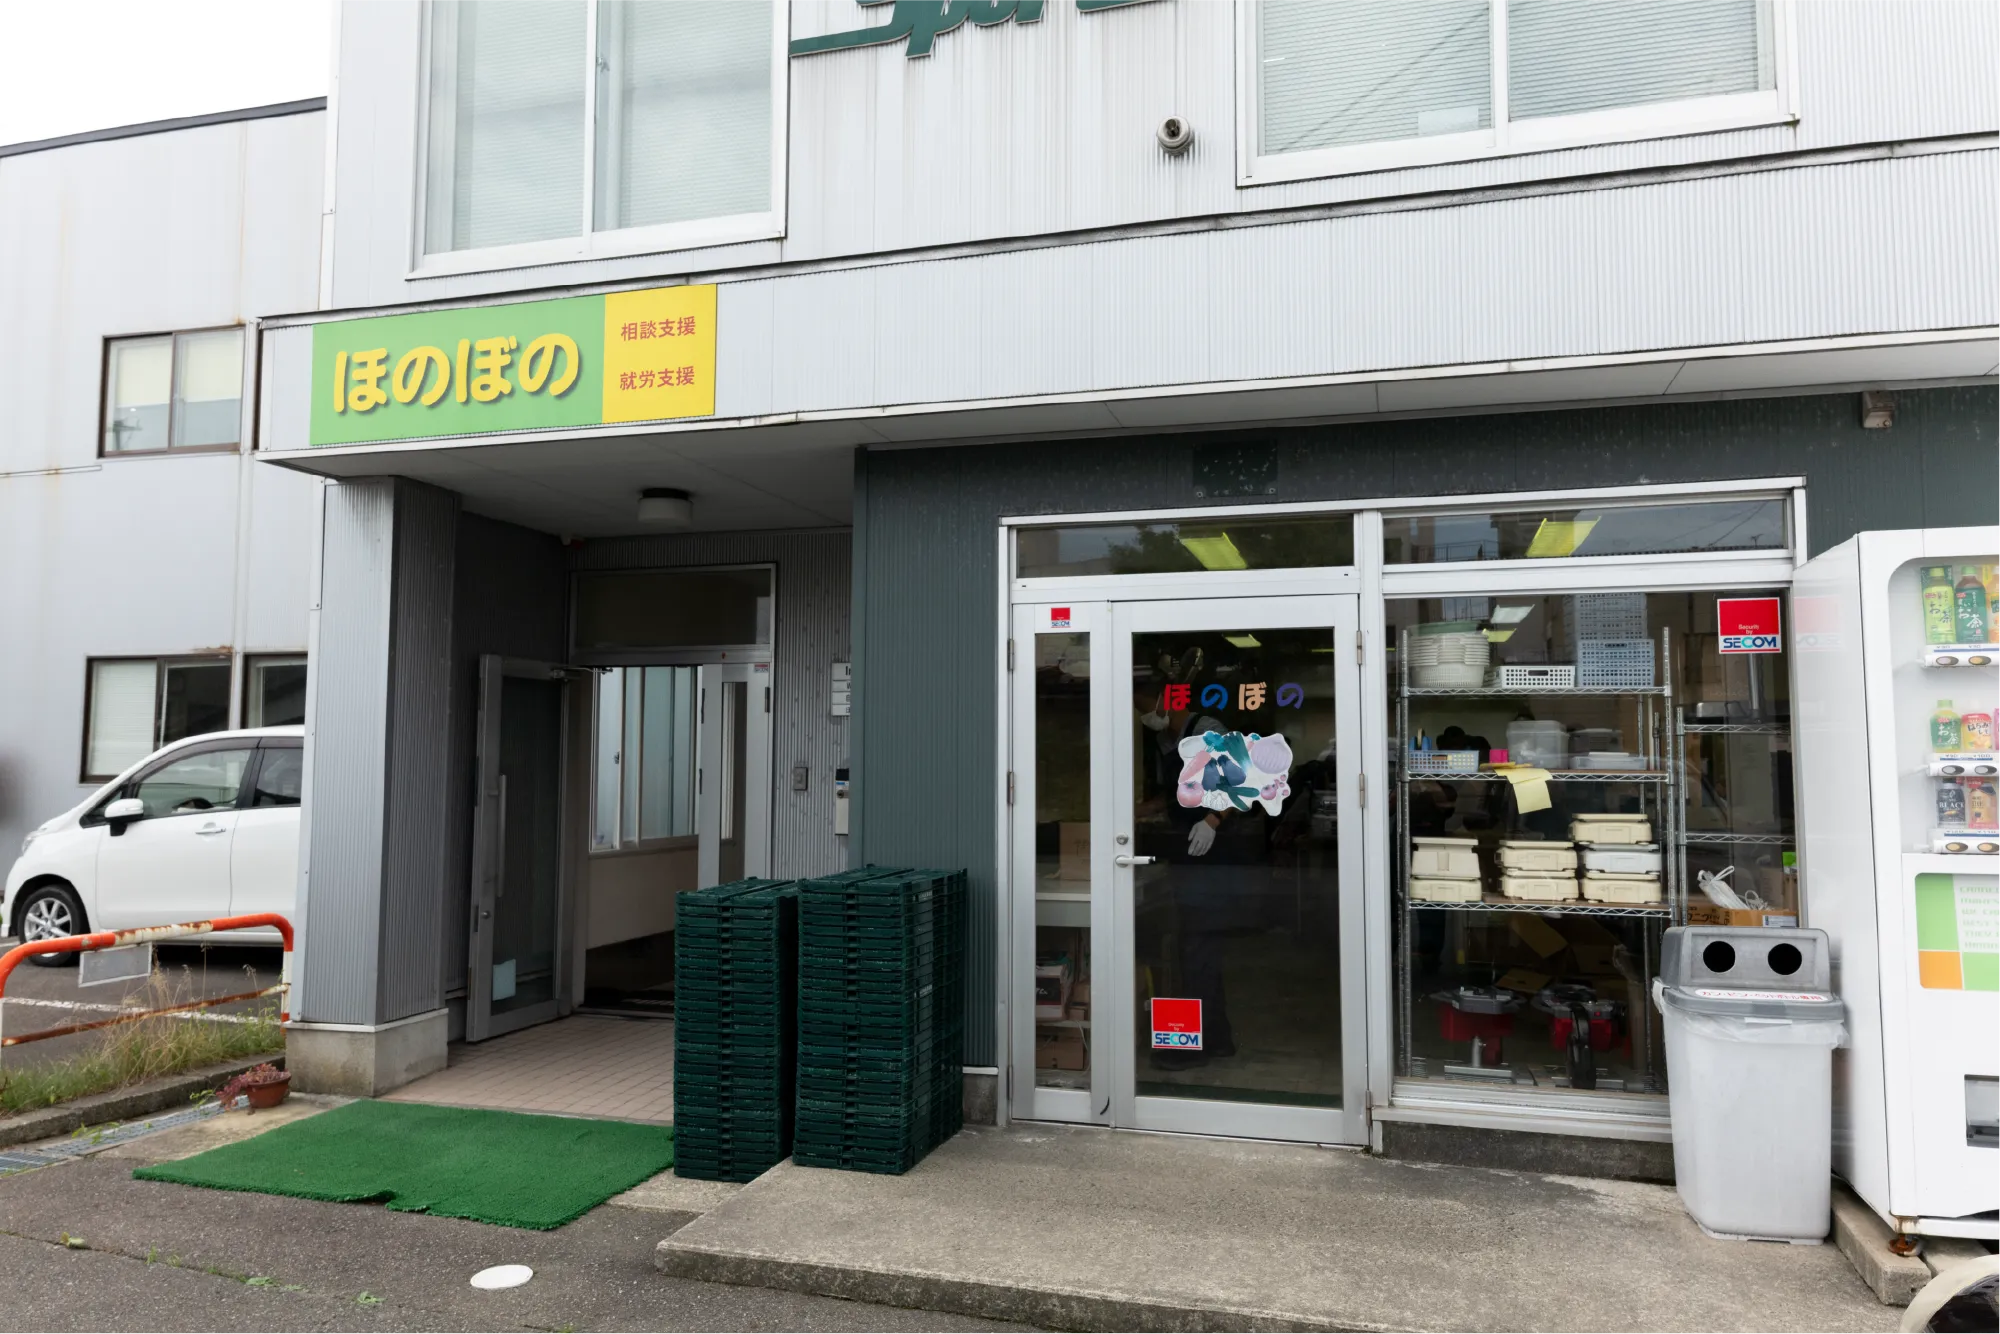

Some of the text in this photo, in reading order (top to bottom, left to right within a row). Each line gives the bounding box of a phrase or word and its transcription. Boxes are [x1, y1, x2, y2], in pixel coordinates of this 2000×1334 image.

[620, 315, 696, 341] 相談支援
[333, 332, 581, 414] ほのぼの
[620, 365, 695, 390] 就労支援
[1723, 636, 1777, 648] SECOM
[1163, 681, 1304, 711] ほのぼの
[1939, 801, 1964, 809] BLACK
[1155, 1032, 1199, 1045] SECOM
